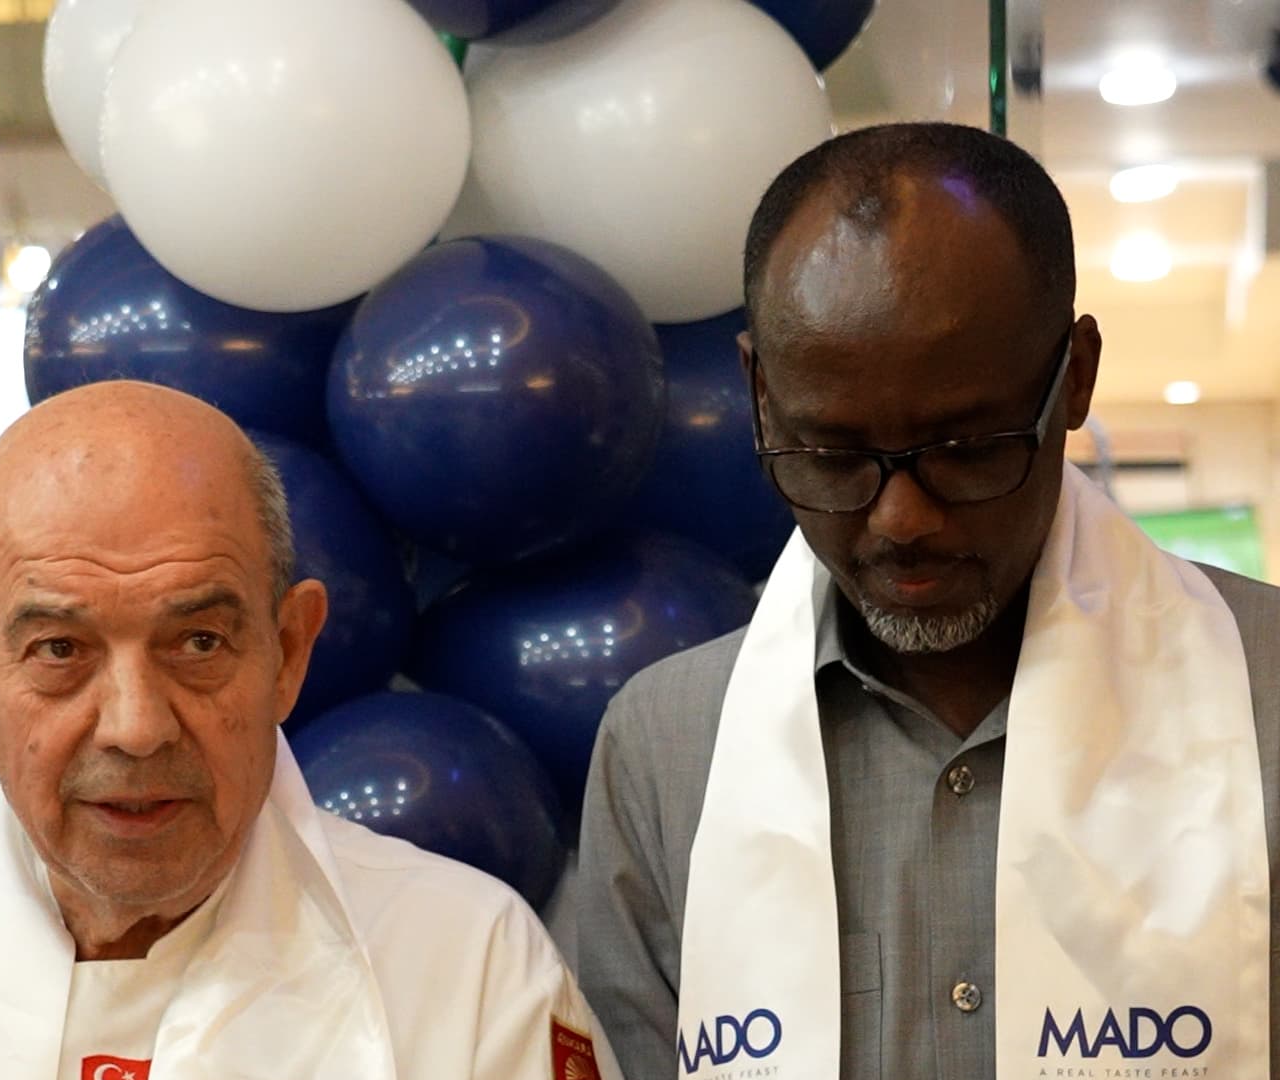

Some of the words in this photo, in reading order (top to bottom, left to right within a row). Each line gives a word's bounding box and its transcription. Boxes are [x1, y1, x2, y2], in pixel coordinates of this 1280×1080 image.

[1037, 1005, 1212, 1058] MADO
[740, 1066, 778, 1079] FEAST
[1039, 1068, 1047, 1077] A
[1057, 1068, 1094, 1078] REAL
[1105, 1068, 1152, 1079] TASTE
[1161, 1066, 1209, 1078] FEAST
